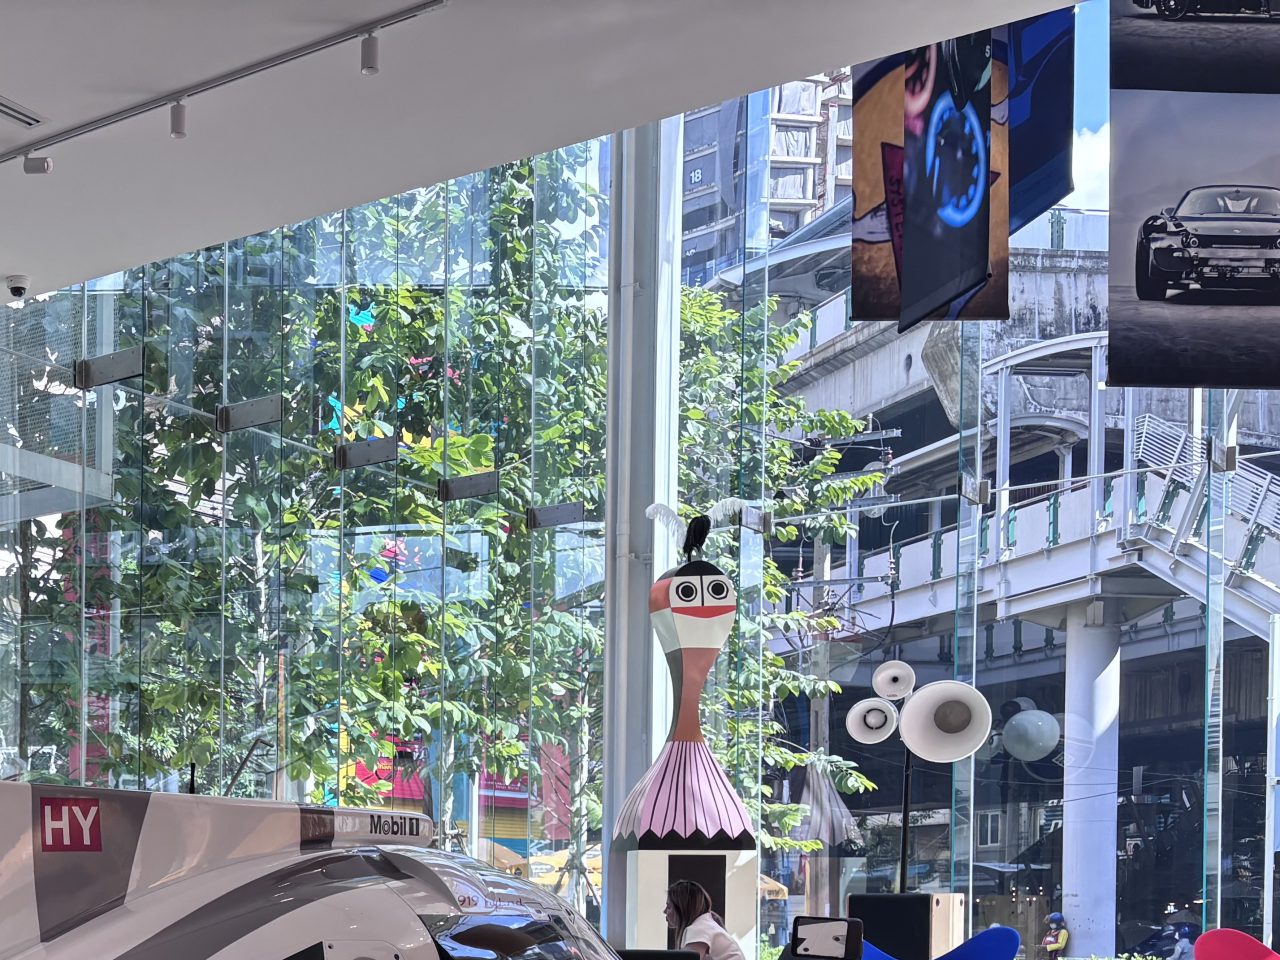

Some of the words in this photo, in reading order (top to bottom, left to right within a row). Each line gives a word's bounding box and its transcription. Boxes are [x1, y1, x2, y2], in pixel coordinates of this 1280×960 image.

[690, 169, 702, 183] 18
[44, 805, 98, 846] HY
[369, 814, 407, 836] Mobil
